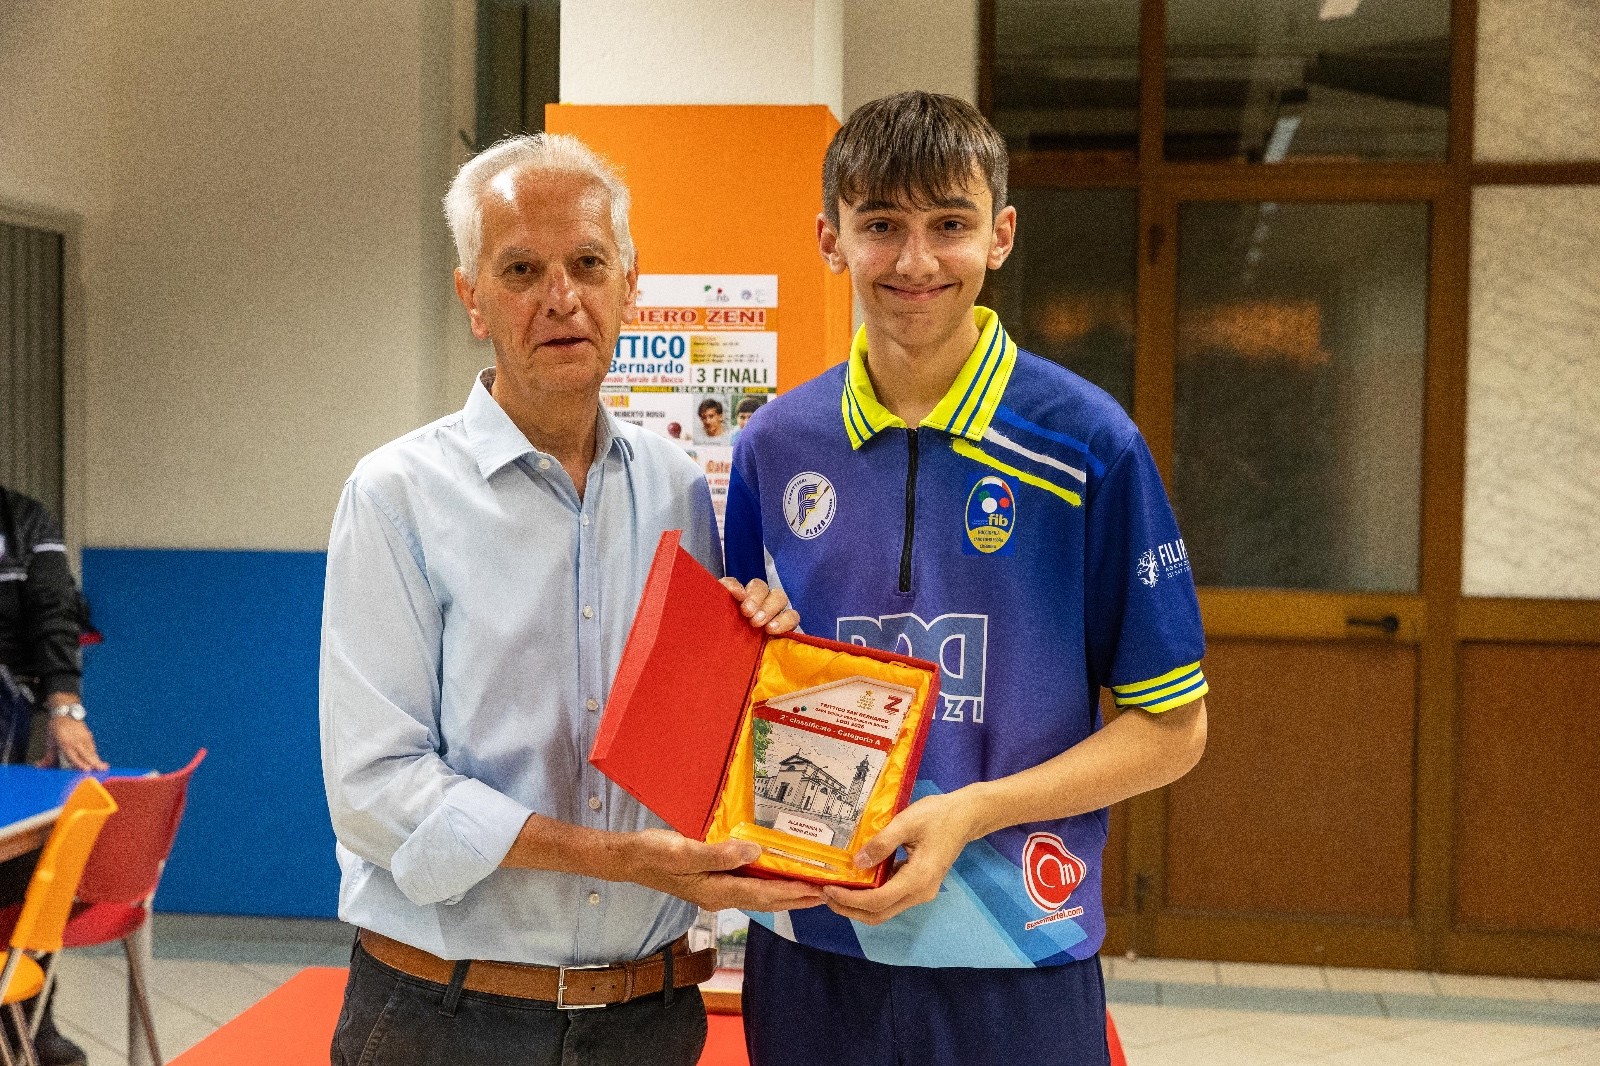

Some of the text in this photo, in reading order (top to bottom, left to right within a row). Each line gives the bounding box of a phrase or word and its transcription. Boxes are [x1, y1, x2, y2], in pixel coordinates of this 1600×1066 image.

[707, 310, 764, 323] ZENI
[608, 360, 684, 374] Bernardo
[697, 368, 767, 383] 3 FINALI
[988, 513, 1009, 527] fib
[837, 729, 874, 744] Categoria
